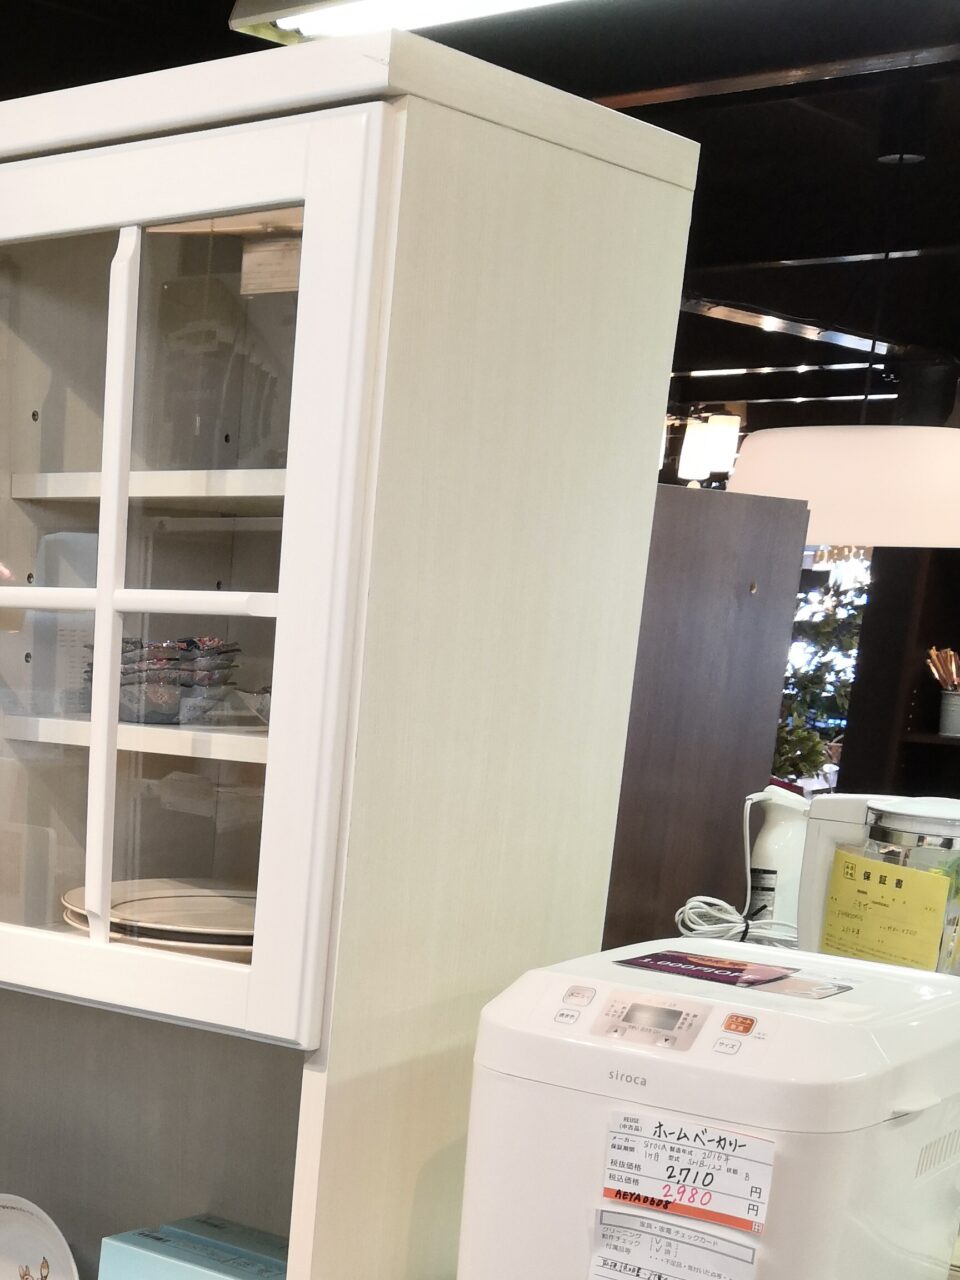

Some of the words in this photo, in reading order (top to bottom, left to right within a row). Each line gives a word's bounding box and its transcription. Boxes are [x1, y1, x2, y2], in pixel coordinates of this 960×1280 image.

[608, 1069, 647, 1087] siroca
[653, 1121, 747, 1152] ホームベーカリー
[608, 1172, 640, 1187] 税込価格
[662, 1183, 712, 1206] 2,980
[747, 1203, 760, 1217] 円
[609, 1158, 642, 1172] 税抜価格
[666, 1165, 715, 1187] 2,710
[750, 1185, 762, 1199] 円
